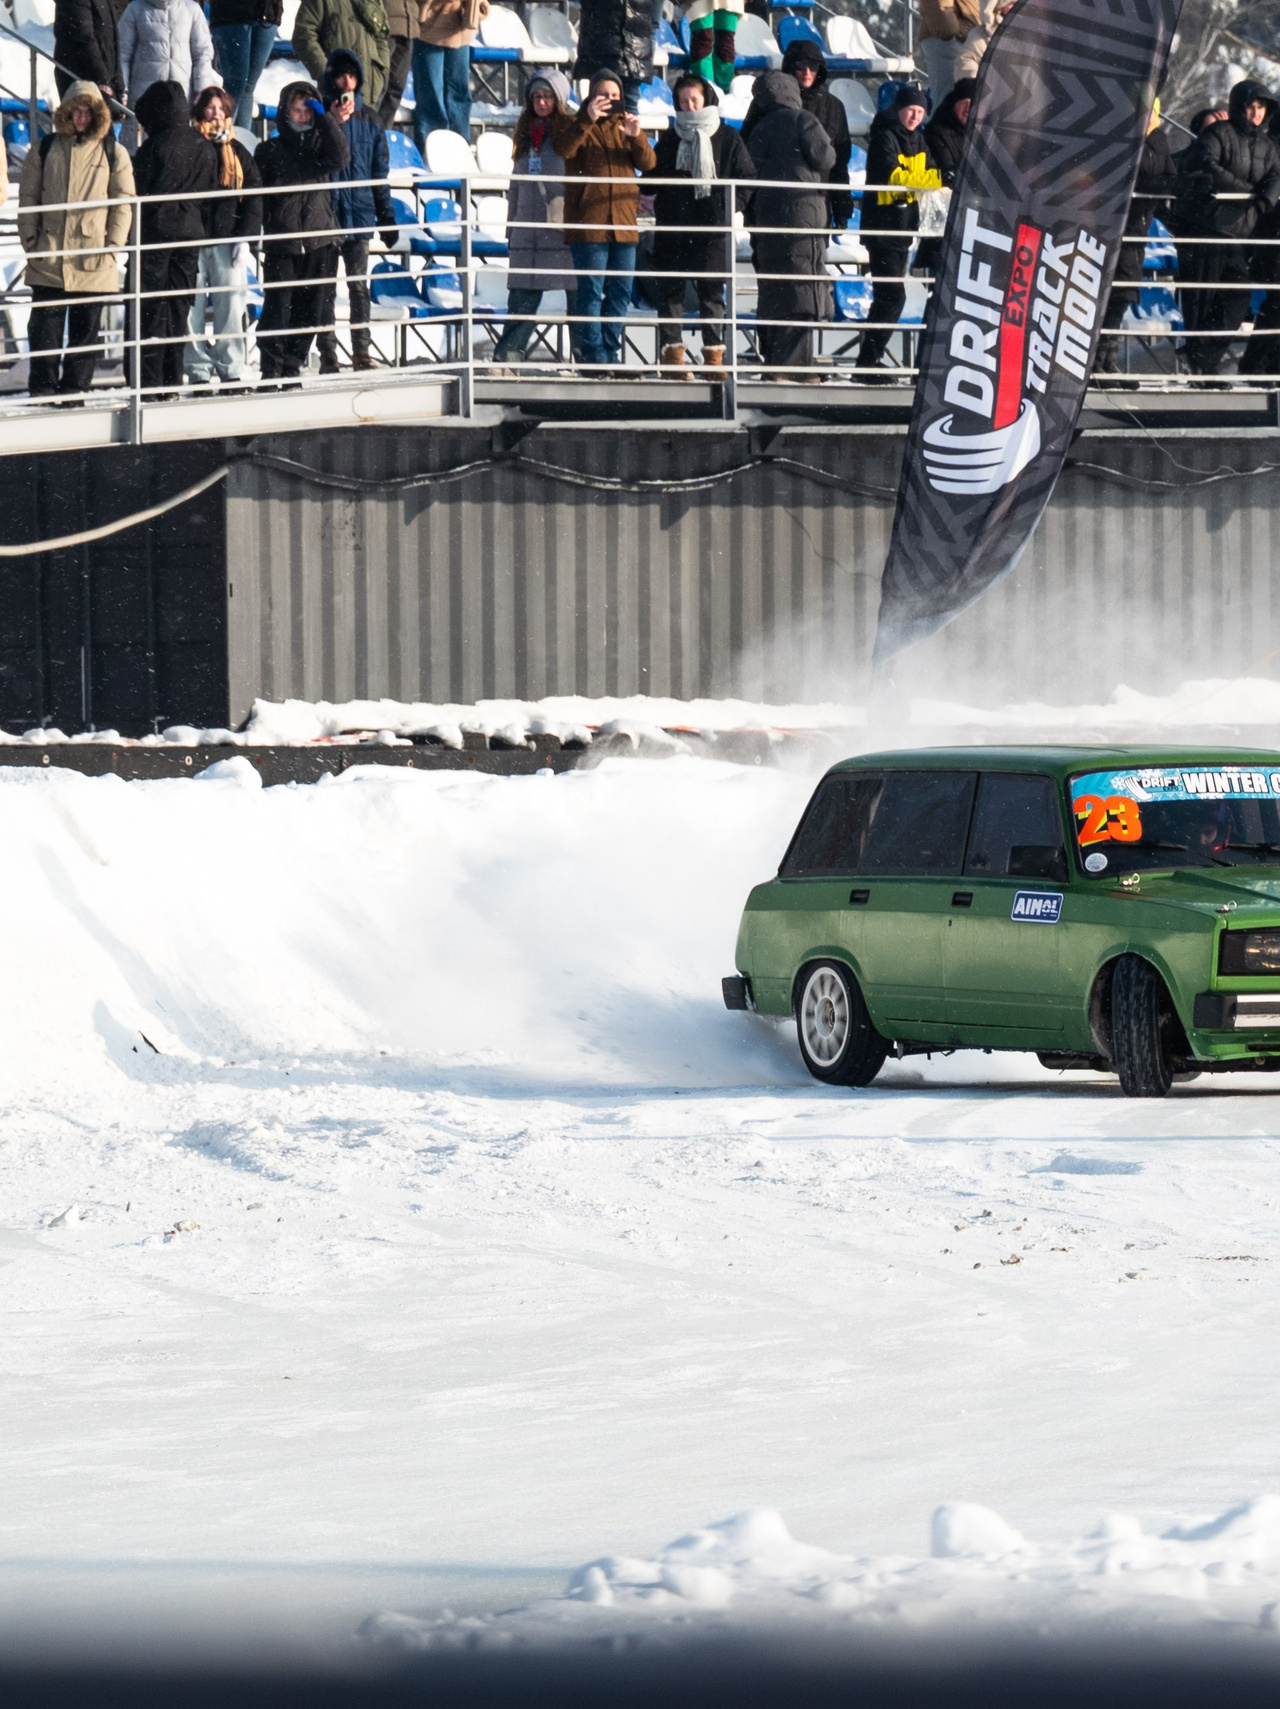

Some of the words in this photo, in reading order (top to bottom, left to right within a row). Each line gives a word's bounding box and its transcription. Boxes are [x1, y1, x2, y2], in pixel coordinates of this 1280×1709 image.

[943, 208, 1013, 419] DRIFT
[1004, 244, 1034, 328] EXPO
[1025, 232, 1075, 394] TRACK
[1054, 229, 1107, 381] MODE
[1141, 776, 1179, 788] DRIFT
[1181, 772, 1269, 794] WINTER
[1073, 794, 1143, 847] 23
[1014, 897, 1058, 916] AIMOL
